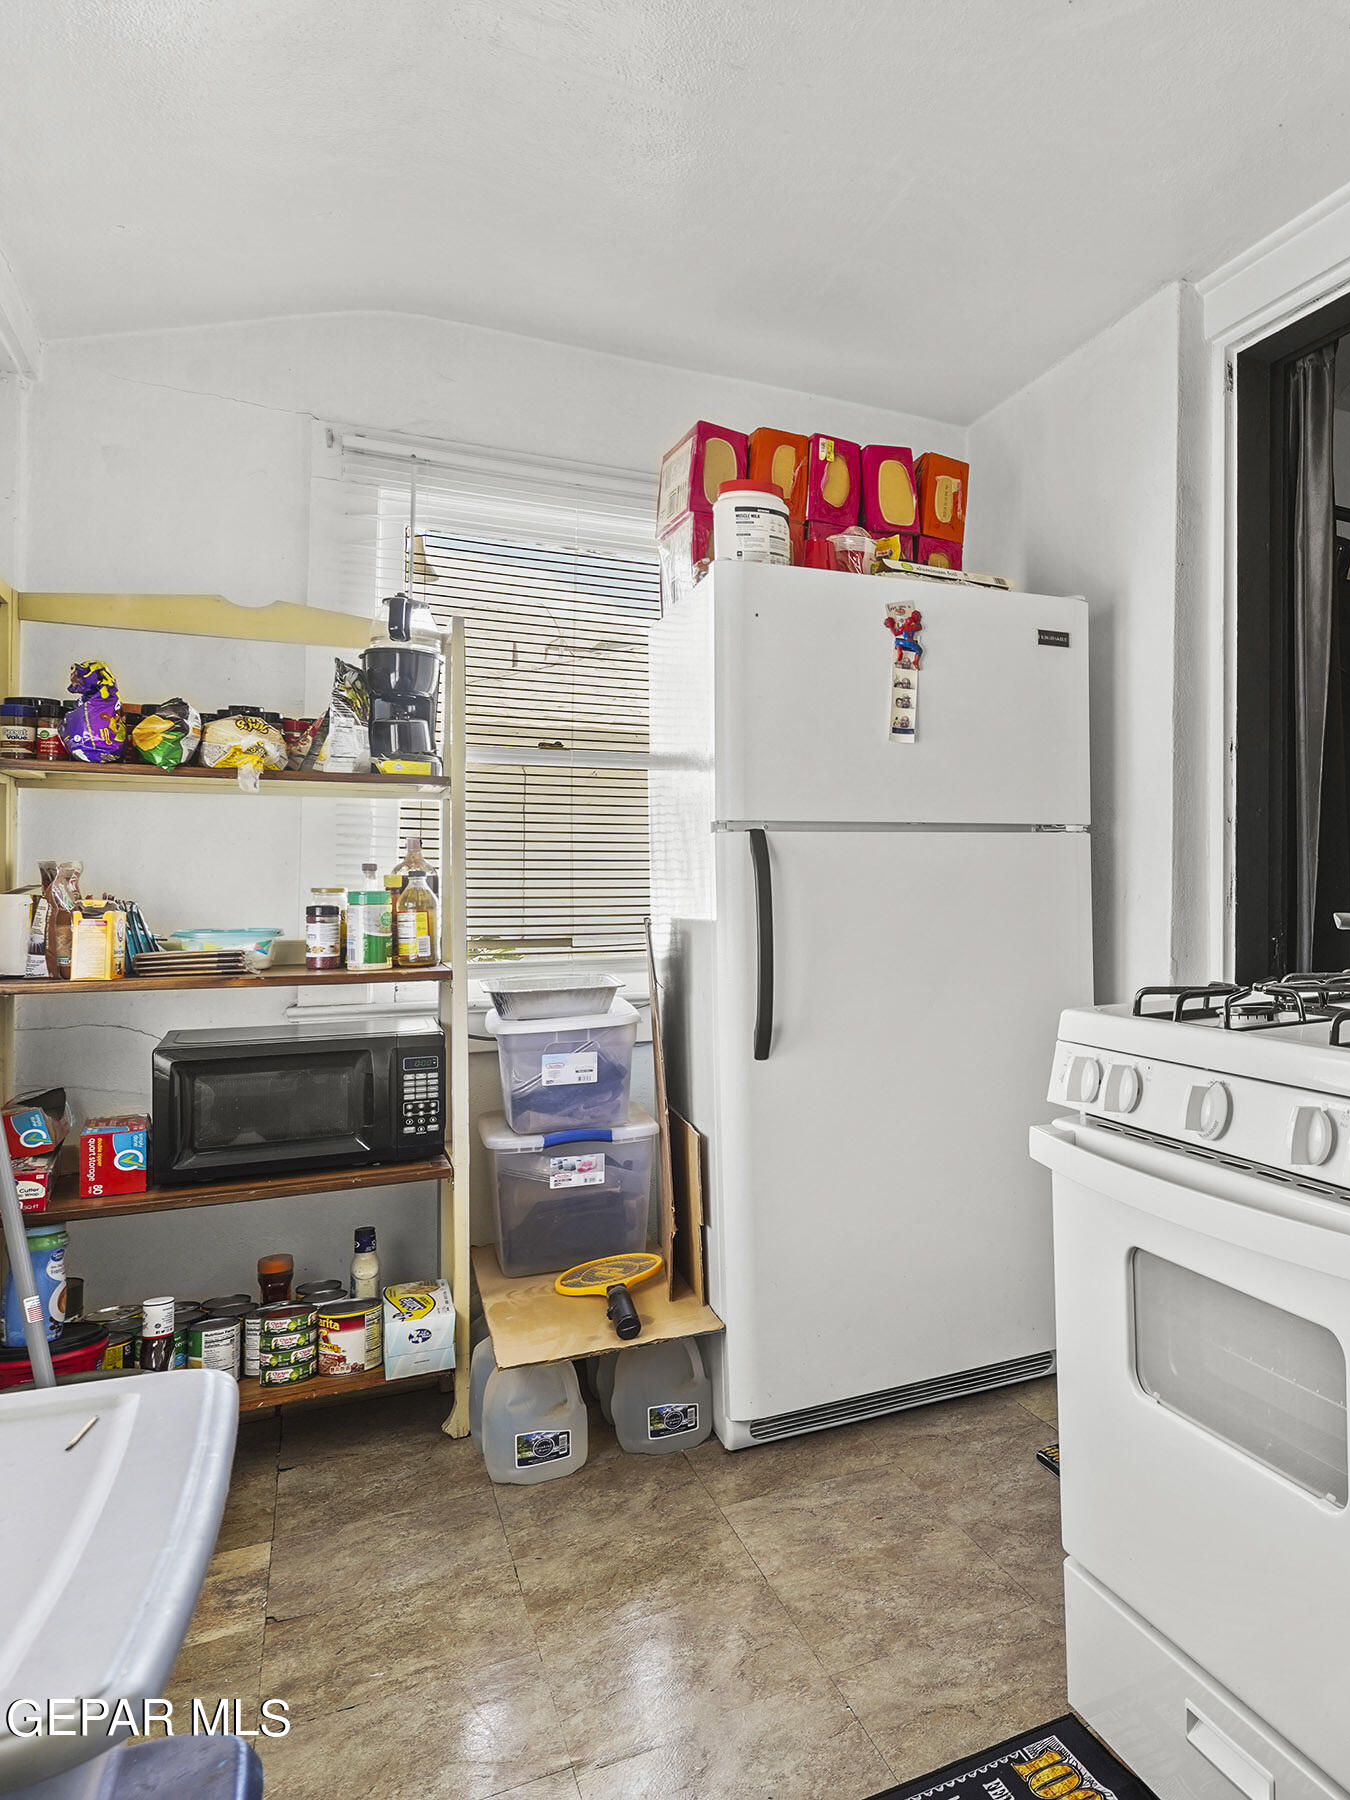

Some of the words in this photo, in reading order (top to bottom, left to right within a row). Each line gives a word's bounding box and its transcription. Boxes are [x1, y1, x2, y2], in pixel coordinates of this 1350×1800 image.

[88, 1138, 96, 1157] quart
[87, 1157, 96, 1182] storage
[93, 1184, 103, 1195] 80
[319, 1318, 340, 1331] arita
